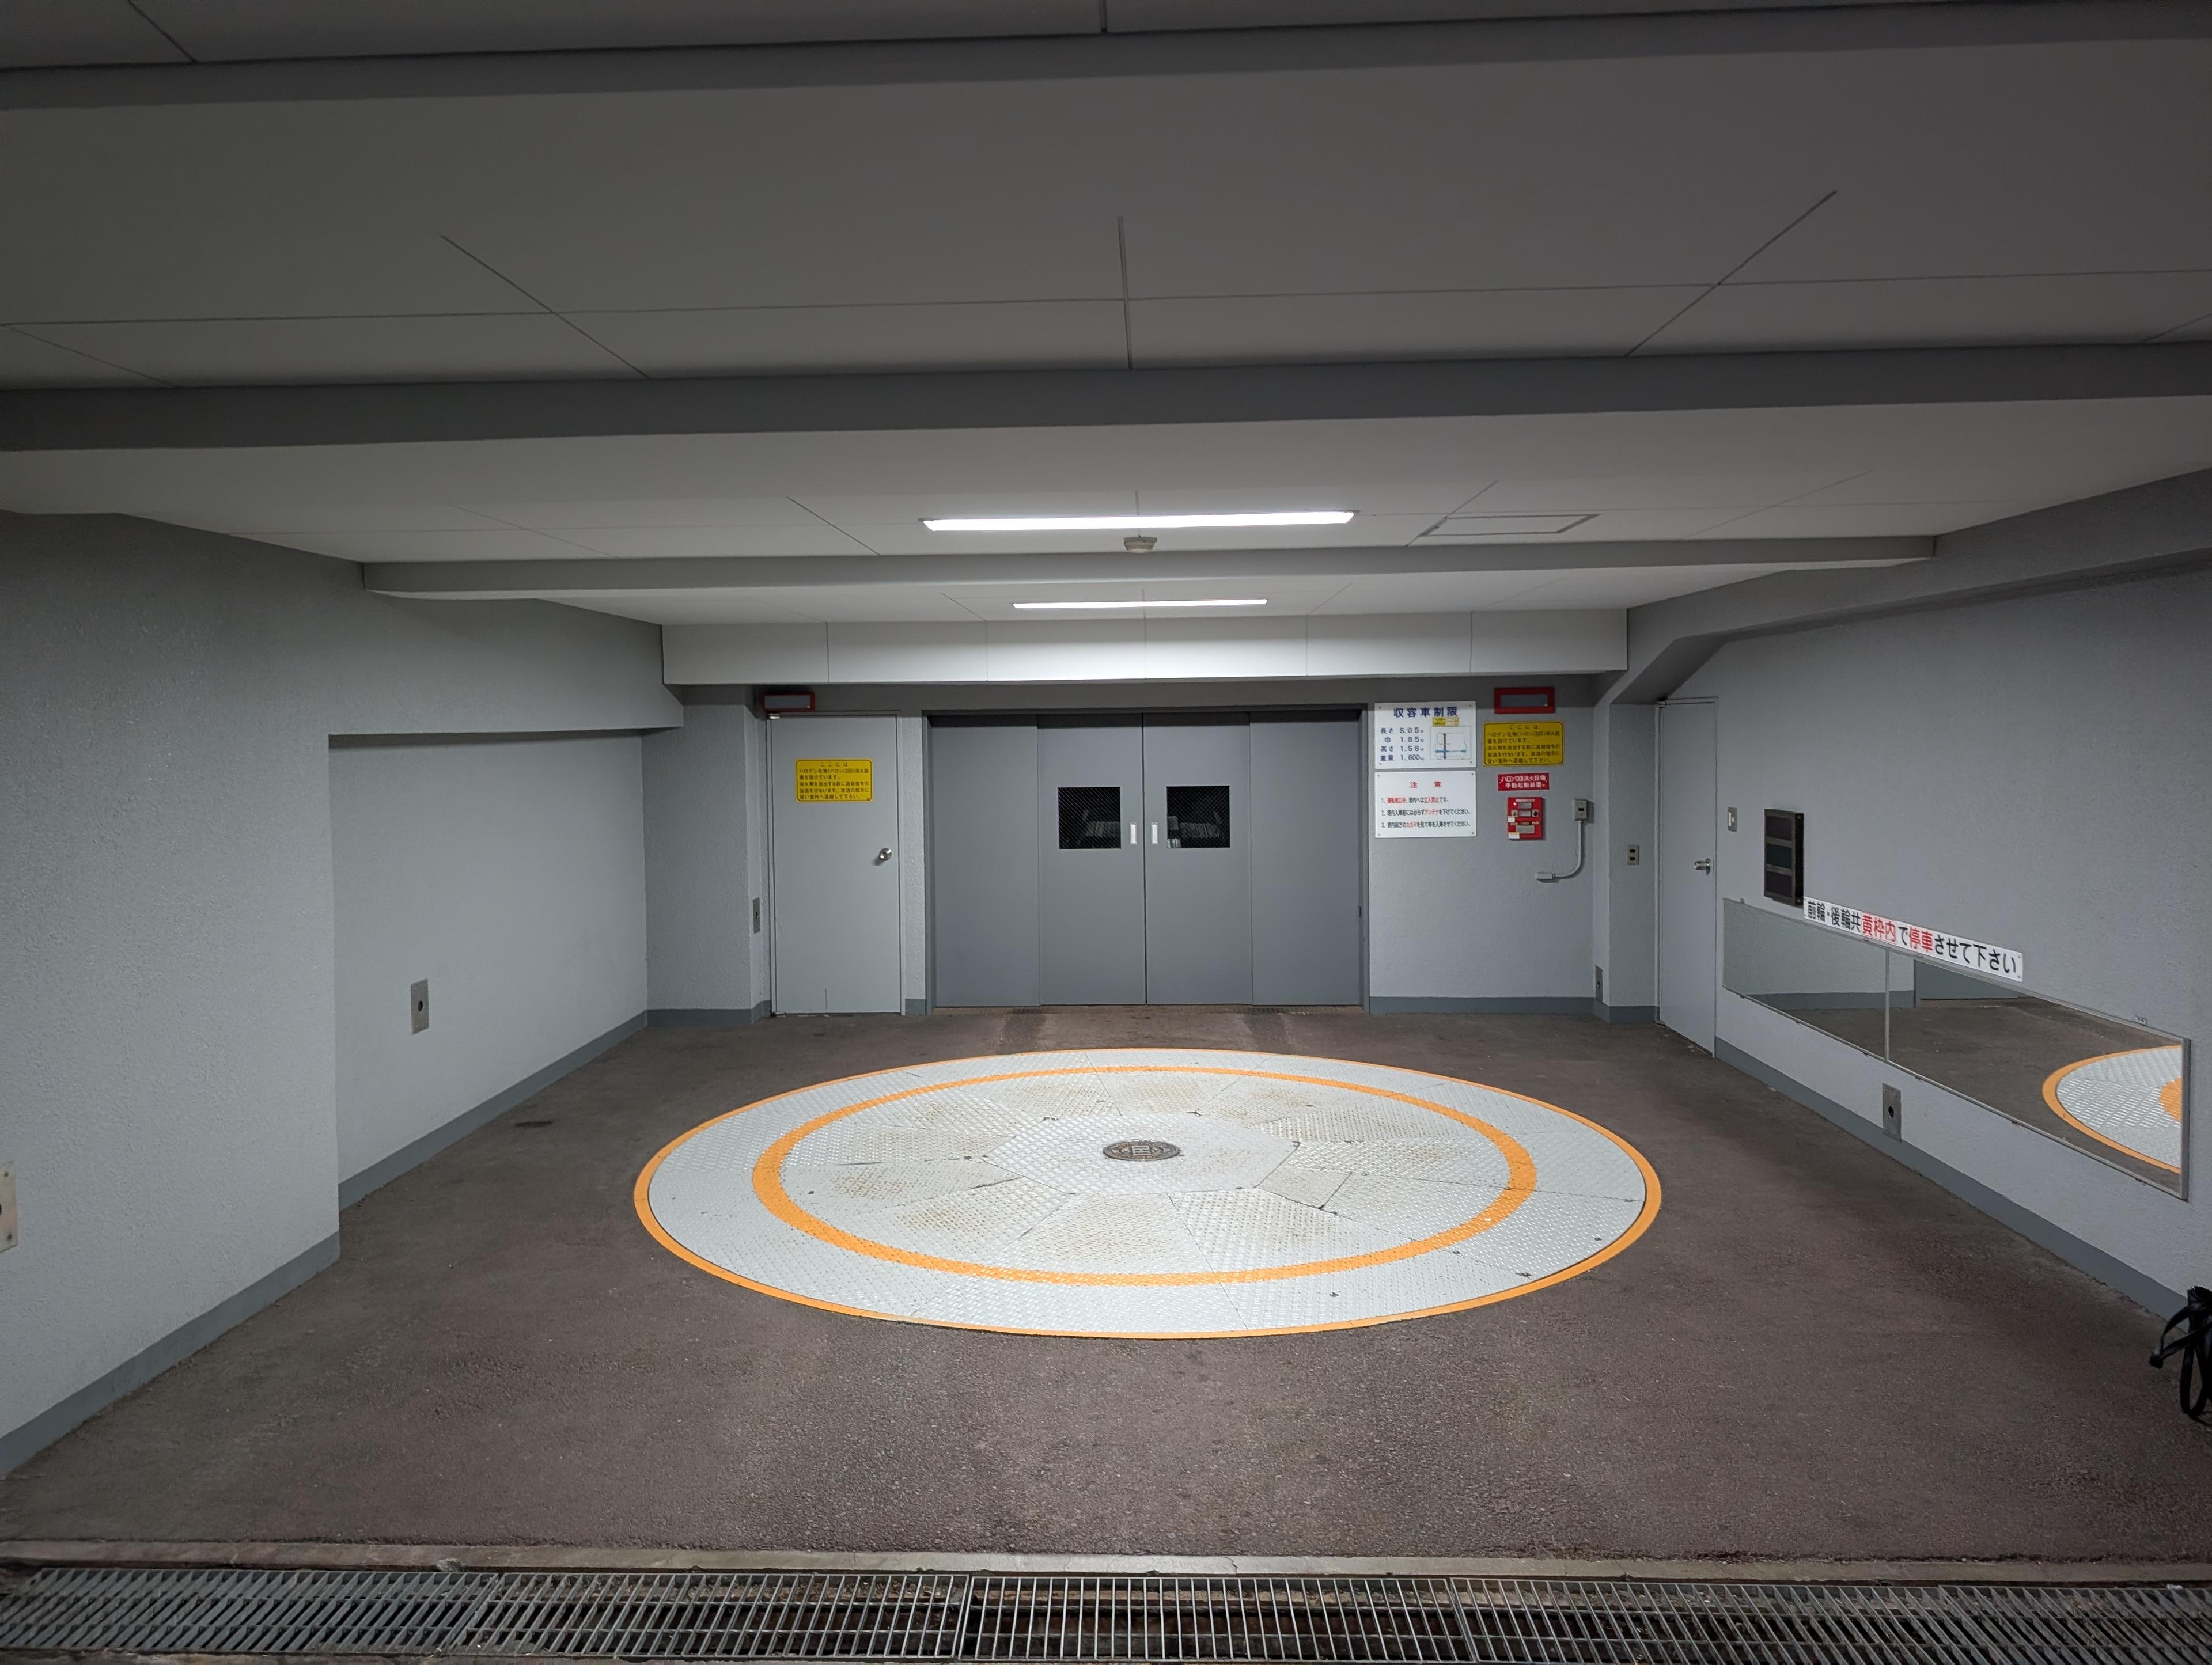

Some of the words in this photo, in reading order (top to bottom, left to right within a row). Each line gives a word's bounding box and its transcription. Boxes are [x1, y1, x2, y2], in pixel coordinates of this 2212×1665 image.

[1393, 707, 1458, 718] 収容車制限
